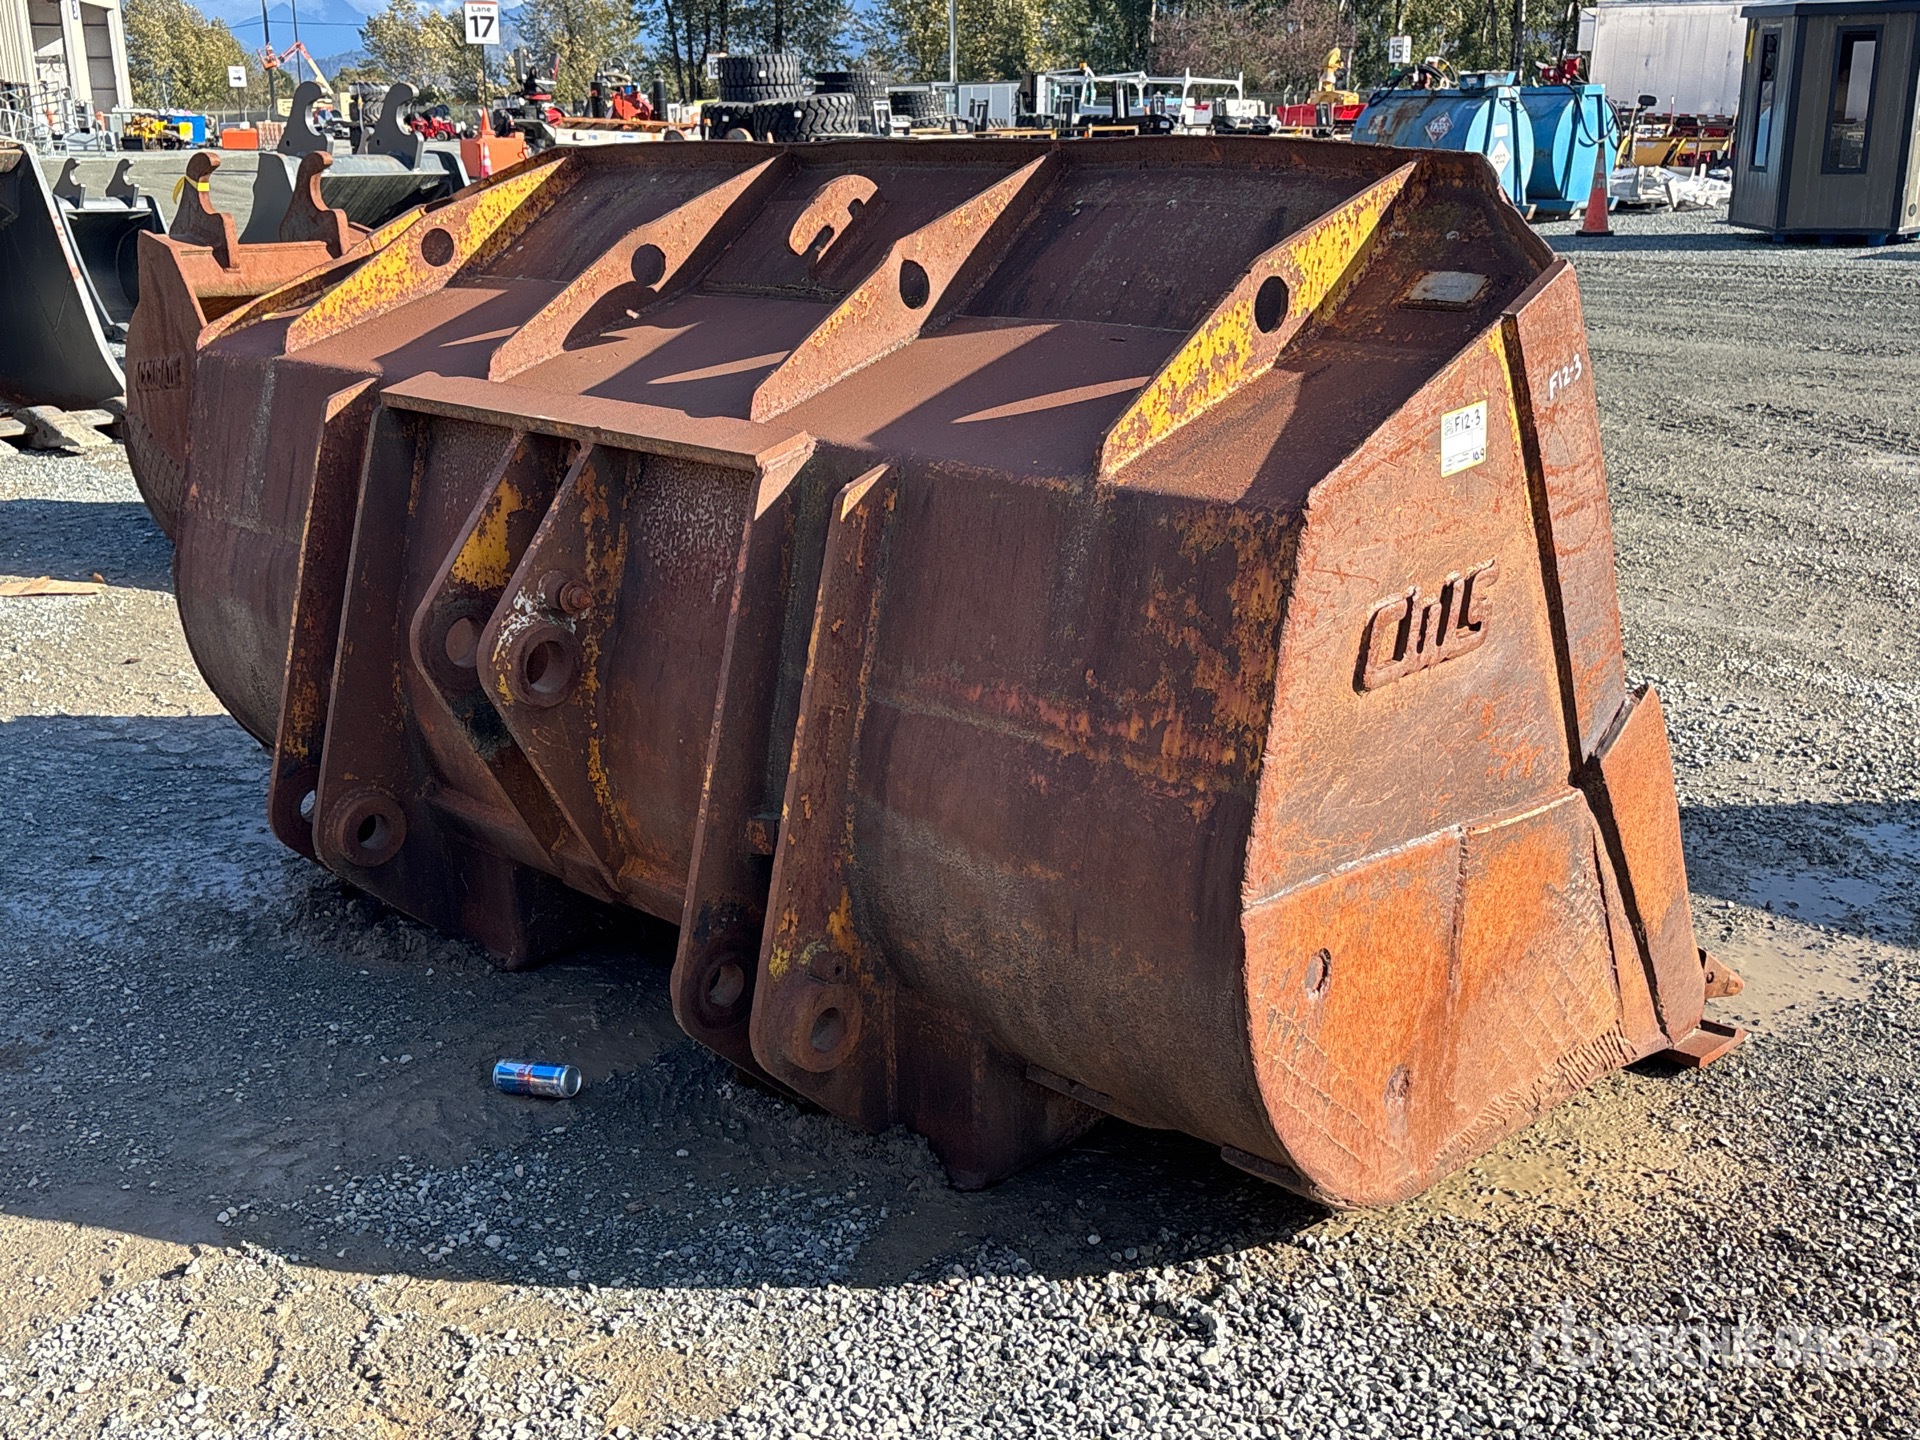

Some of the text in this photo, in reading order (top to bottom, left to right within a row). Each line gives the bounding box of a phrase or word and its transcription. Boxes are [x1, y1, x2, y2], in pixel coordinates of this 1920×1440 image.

[469, 15, 495, 38] 17
[1391, 44, 1403, 60] 15
[1549, 353, 1583, 401] F12-3
